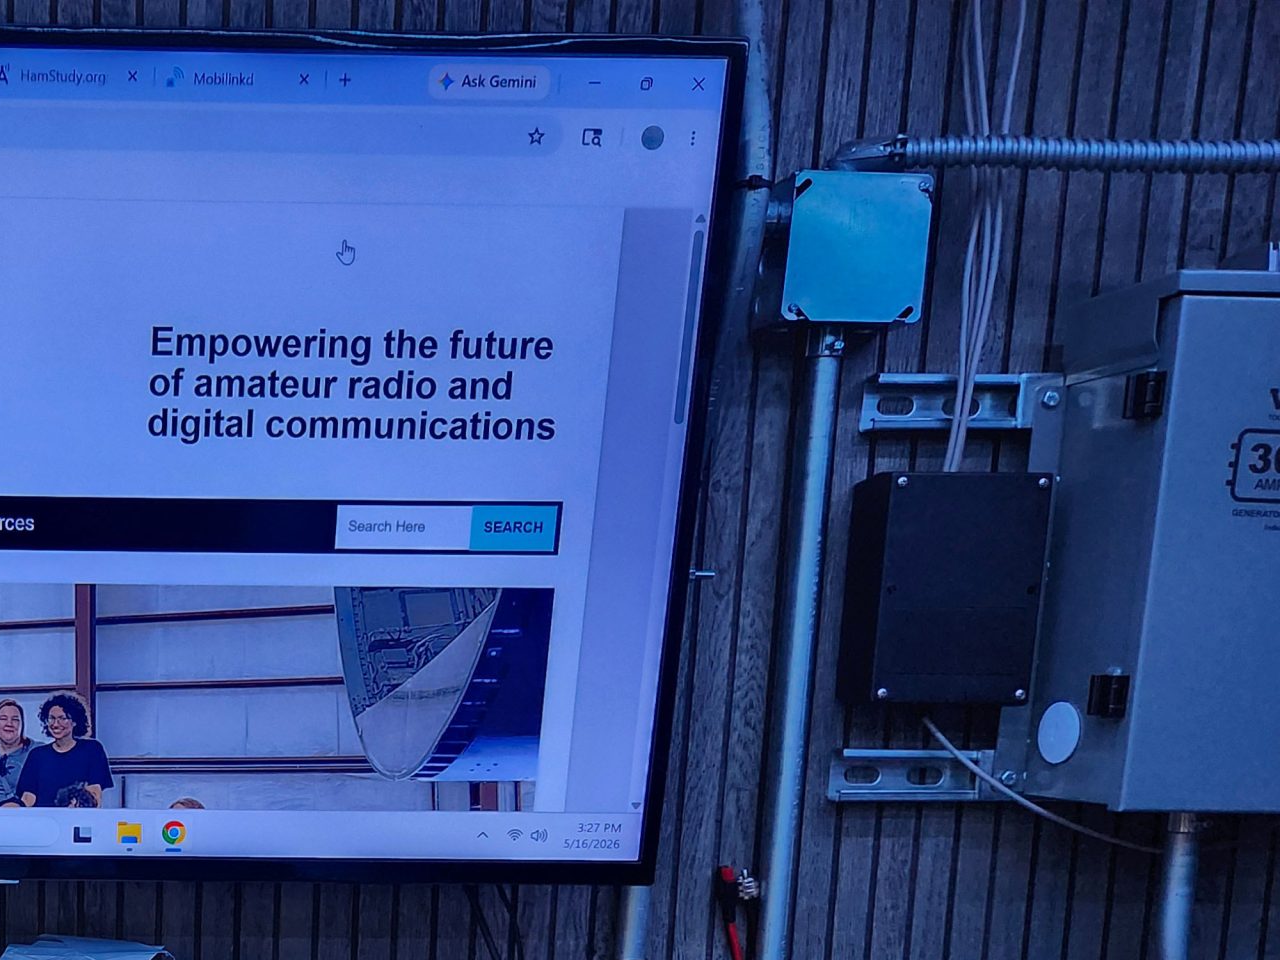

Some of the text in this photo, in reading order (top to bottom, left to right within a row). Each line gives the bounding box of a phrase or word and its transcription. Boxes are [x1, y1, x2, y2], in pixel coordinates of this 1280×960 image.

[20, 69, 107, 87] HamStudy.org
[193, 71, 255, 87] Mobilinkd
[461, 73, 537, 89] Ask Gemini
[150, 325, 555, 366] Empowering the future
[148, 367, 514, 401] of amateur radio and
[147, 408, 557, 445] digital communications
[348, 519, 426, 533] Search Here
[483, 521, 544, 534] SEARCH
[577, 822, 622, 834] 3:27 PM
[563, 838, 621, 851] 5/16/2026
